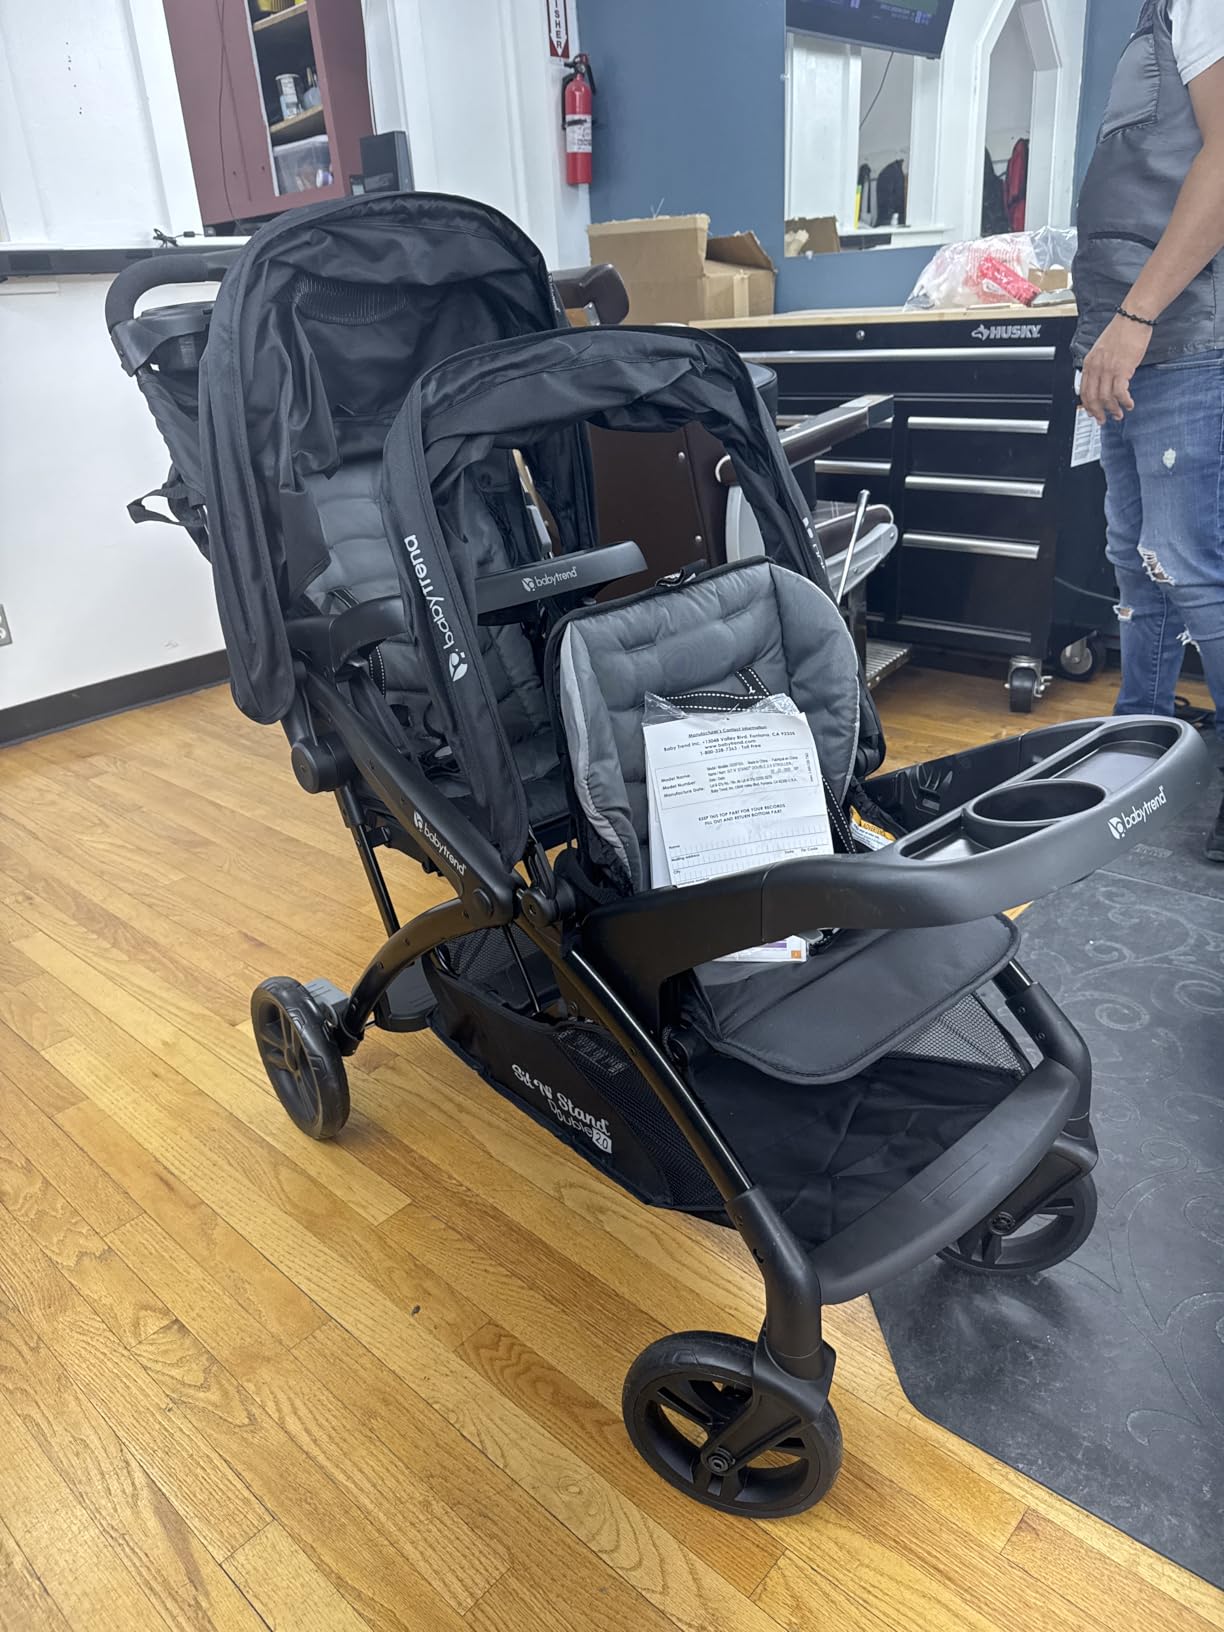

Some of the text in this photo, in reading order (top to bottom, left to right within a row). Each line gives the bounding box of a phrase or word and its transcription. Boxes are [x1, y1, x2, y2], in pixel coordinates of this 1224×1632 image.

[989, 324, 1041, 339] HUSKY
[534, 566, 577, 586] babytrend
[1121, 785, 1167, 829] babytrend
[424, 822, 466, 876] babytrend
[512, 1064, 535, 1089] Sit
[547, 1098, 611, 1151] Double 2.0
